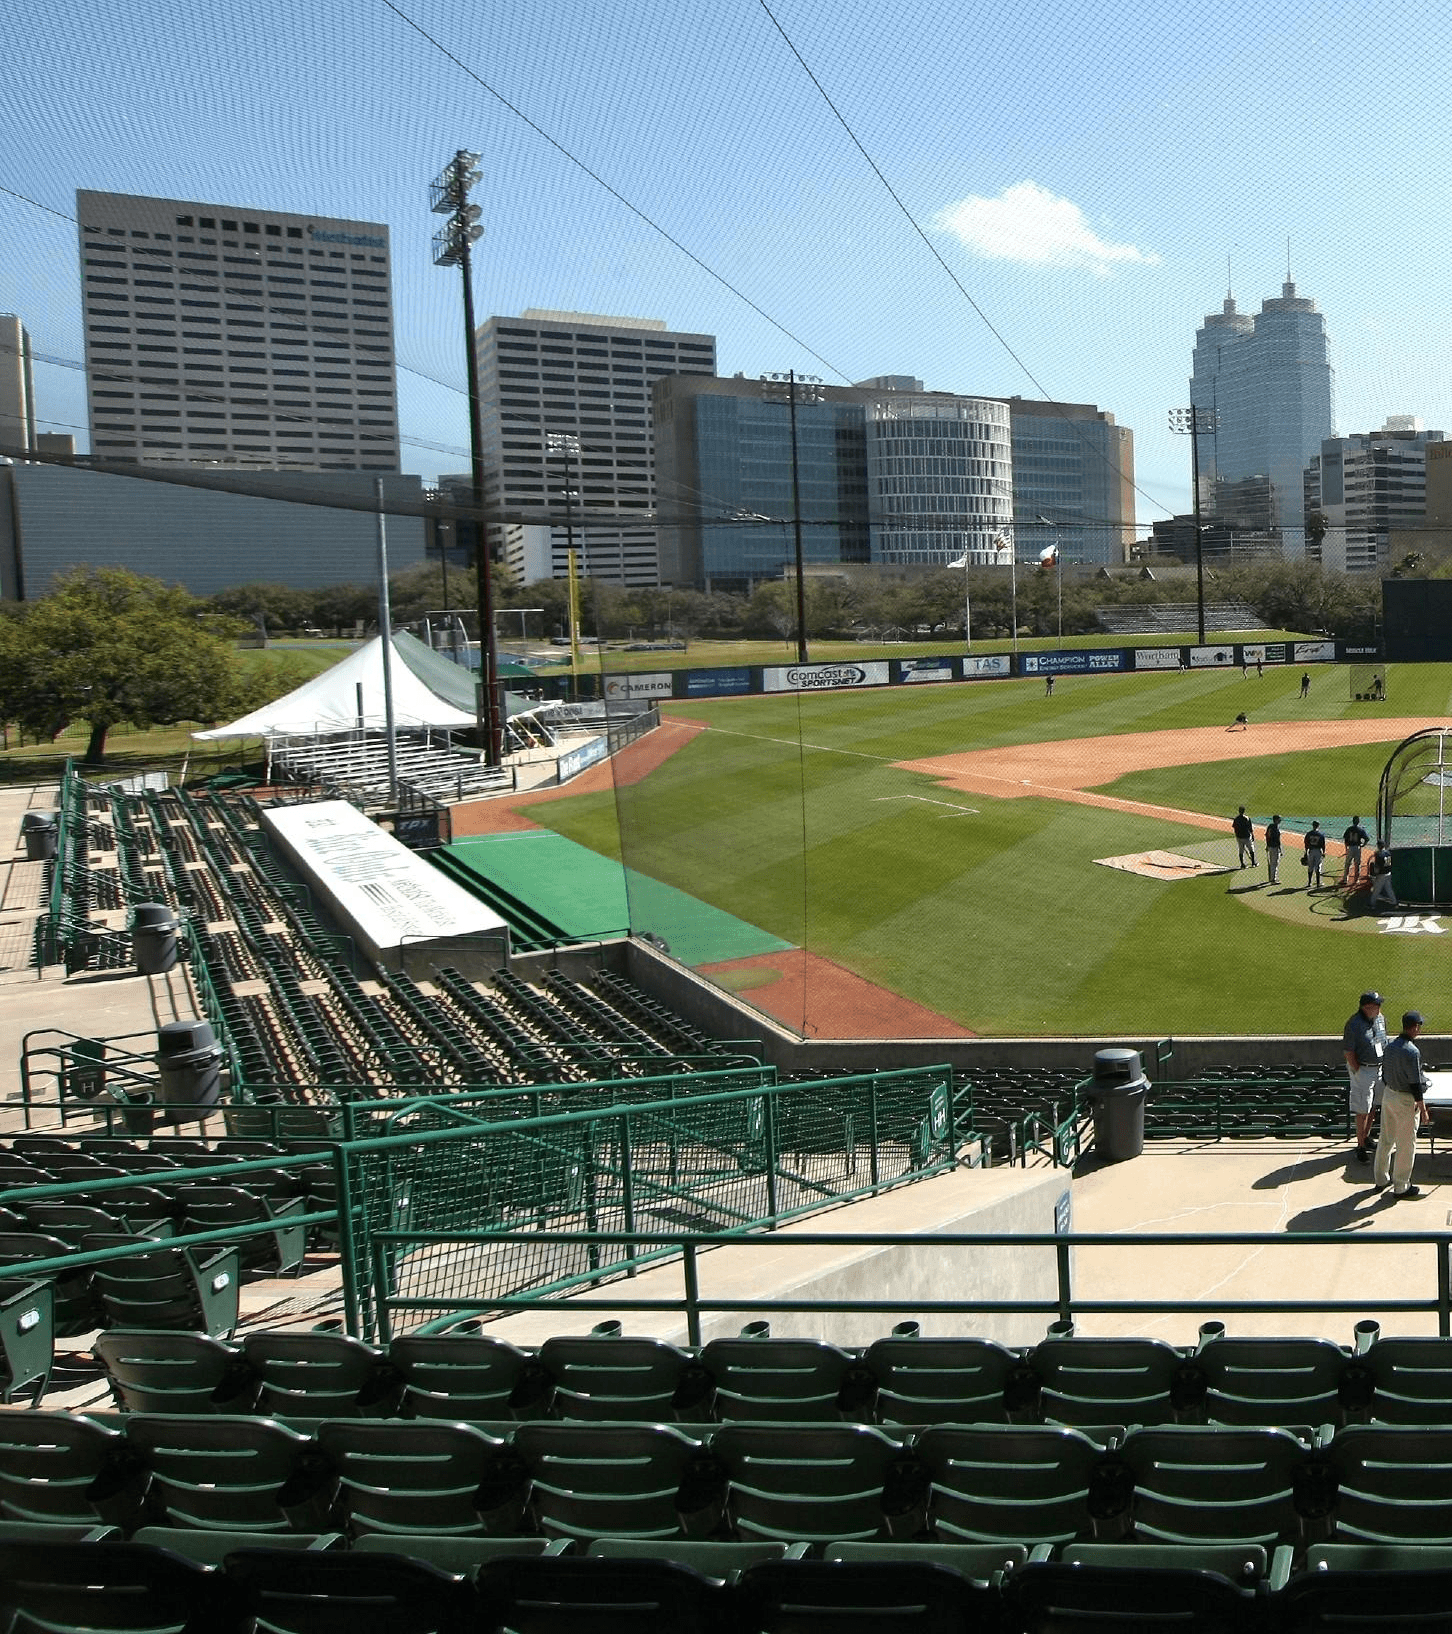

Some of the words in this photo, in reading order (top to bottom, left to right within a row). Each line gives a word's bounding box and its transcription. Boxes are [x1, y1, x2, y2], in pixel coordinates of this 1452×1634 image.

[974, 658, 1001, 670] TAS
[620, 682, 672, 692] CAMERON
[801, 677, 855, 687] SPORTSNET
